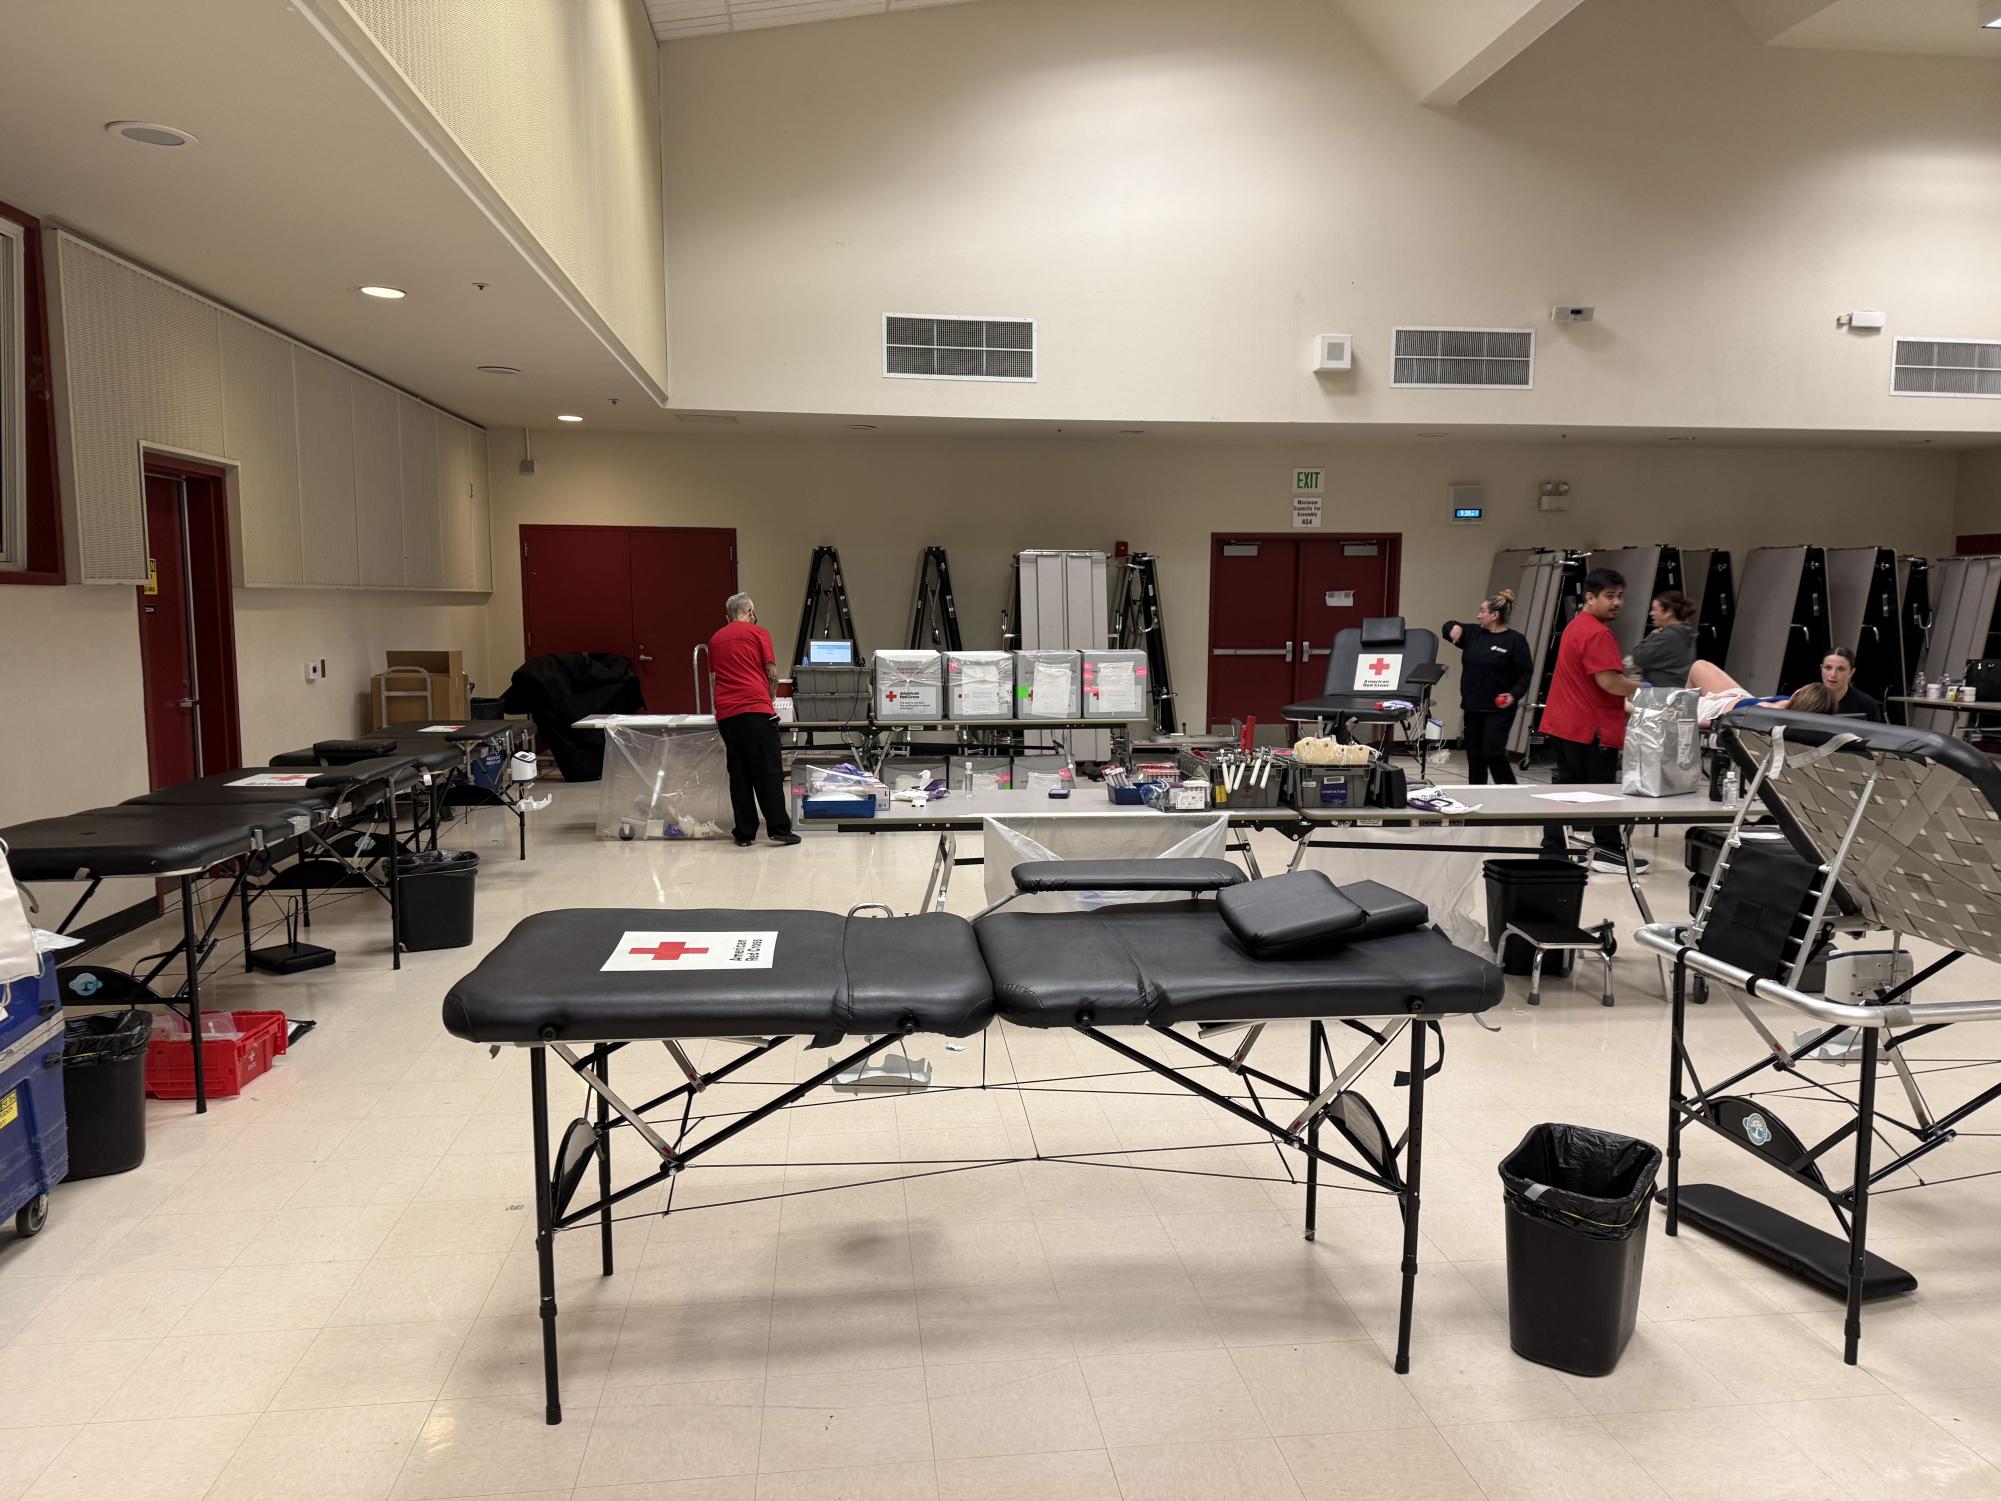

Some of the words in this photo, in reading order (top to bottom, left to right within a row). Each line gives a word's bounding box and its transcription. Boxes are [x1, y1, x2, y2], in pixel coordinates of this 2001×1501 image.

[1296, 472, 1320, 488] EXIT
[729, 939, 747, 961] American
[747, 939, 763, 952] Cross
[745, 952, 760, 961] Red
